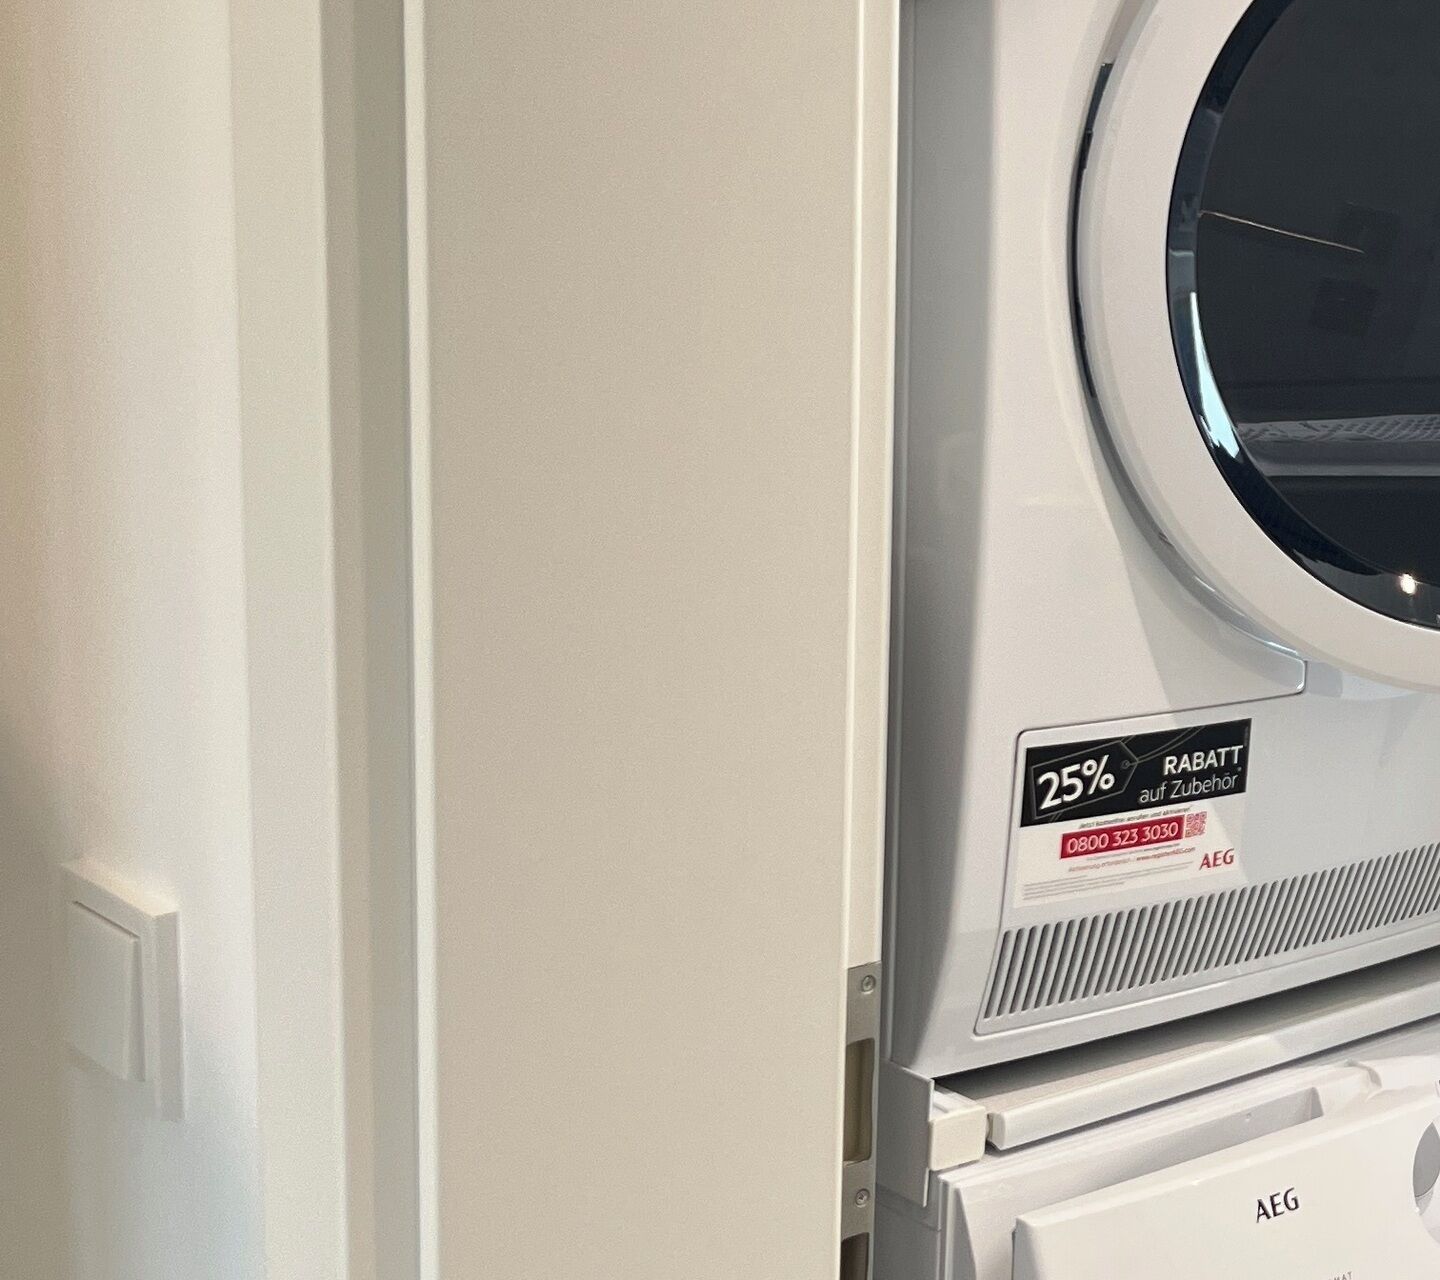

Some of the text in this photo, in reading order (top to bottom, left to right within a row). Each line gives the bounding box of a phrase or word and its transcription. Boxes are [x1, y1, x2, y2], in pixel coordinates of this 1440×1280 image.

[1163, 745, 1244, 776] RABATT
[1037, 754, 1116, 810] 25%
[1139, 772, 1239, 803] auf Zubehör
[1067, 833, 1109, 855] 0800
[1113, 828, 1139, 847] 323
[1142, 822, 1179, 842] 3030
[1199, 848, 1235, 871] AEG
[1256, 1187, 1300, 1223] AEG
